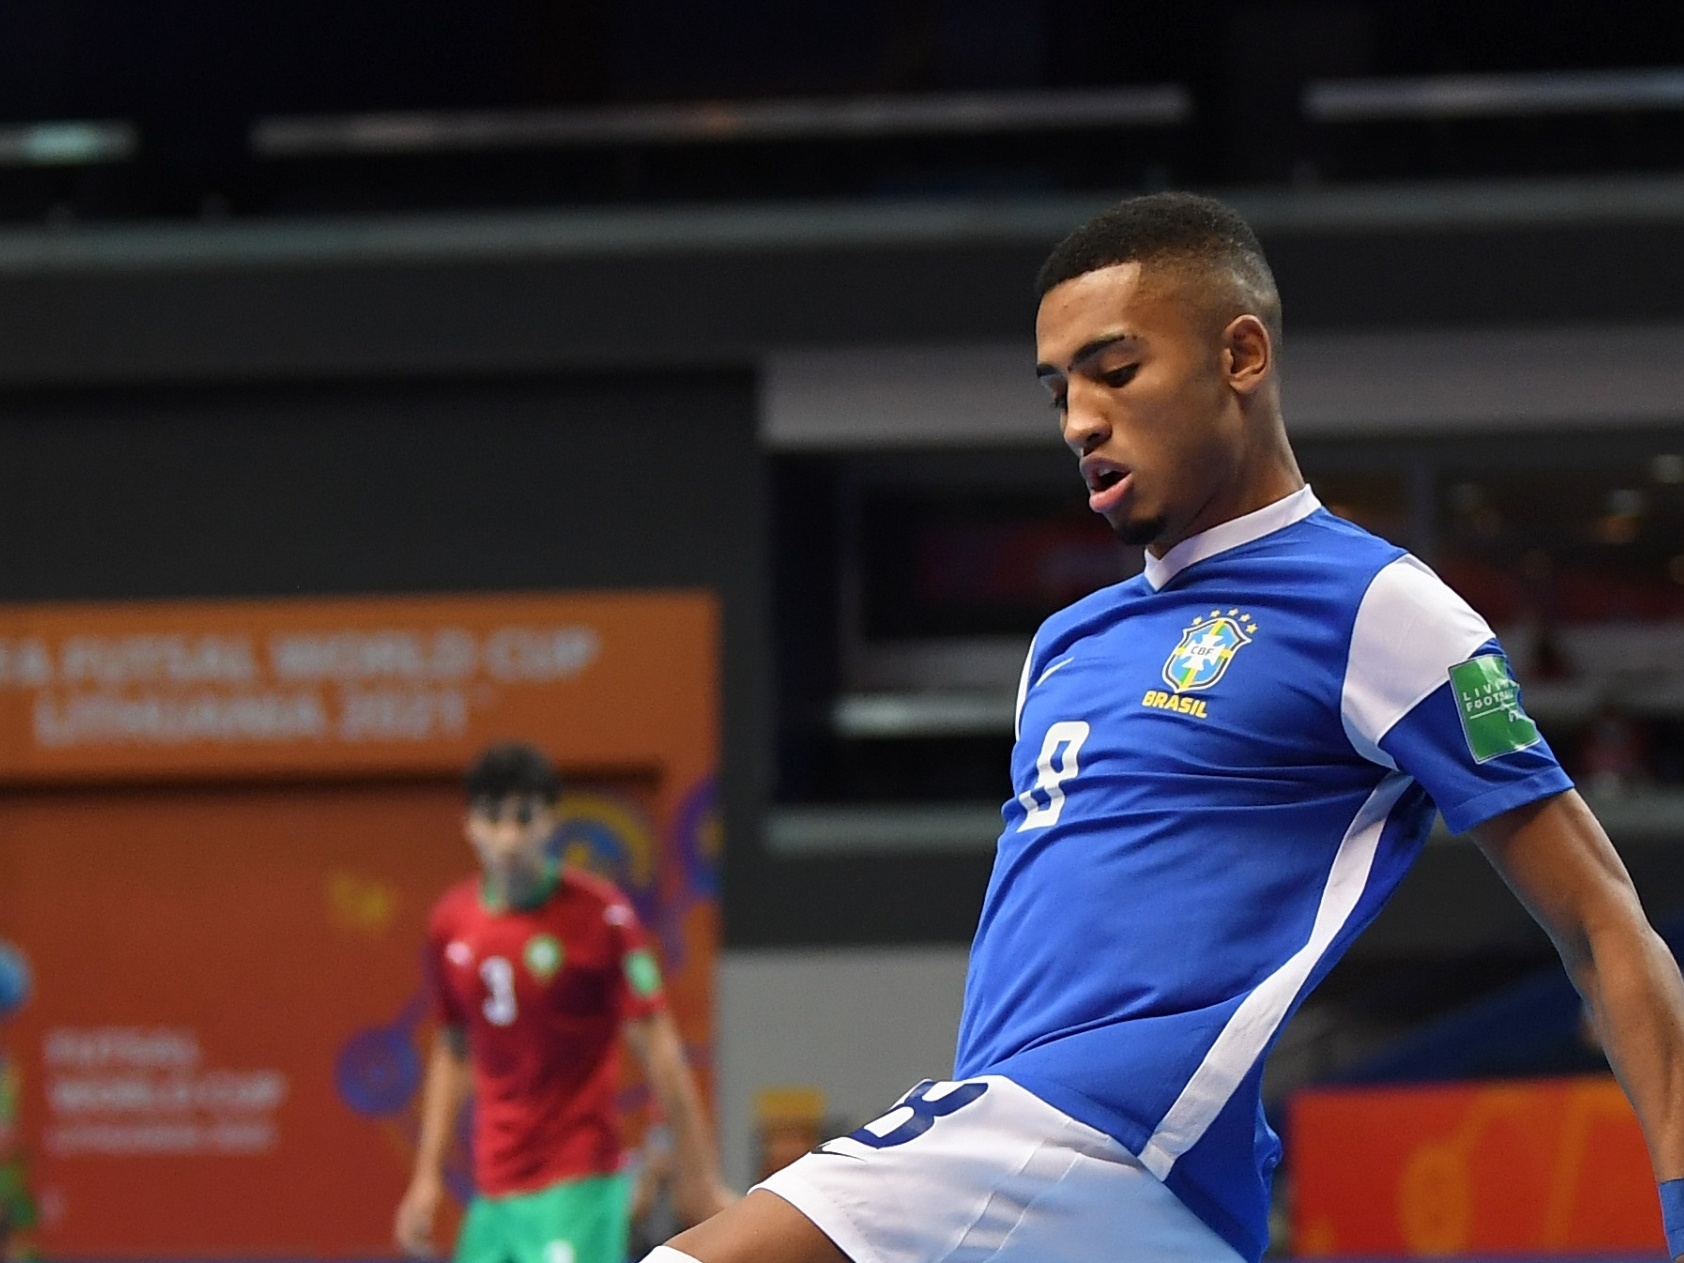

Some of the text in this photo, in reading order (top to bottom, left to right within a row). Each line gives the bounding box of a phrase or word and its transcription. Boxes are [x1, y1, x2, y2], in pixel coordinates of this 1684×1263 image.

[271, 628, 475, 682] WORLD
[484, 622, 600, 682] CUP
[1190, 645, 1214, 656] CBF
[1141, 690, 1208, 719] BRASIL
